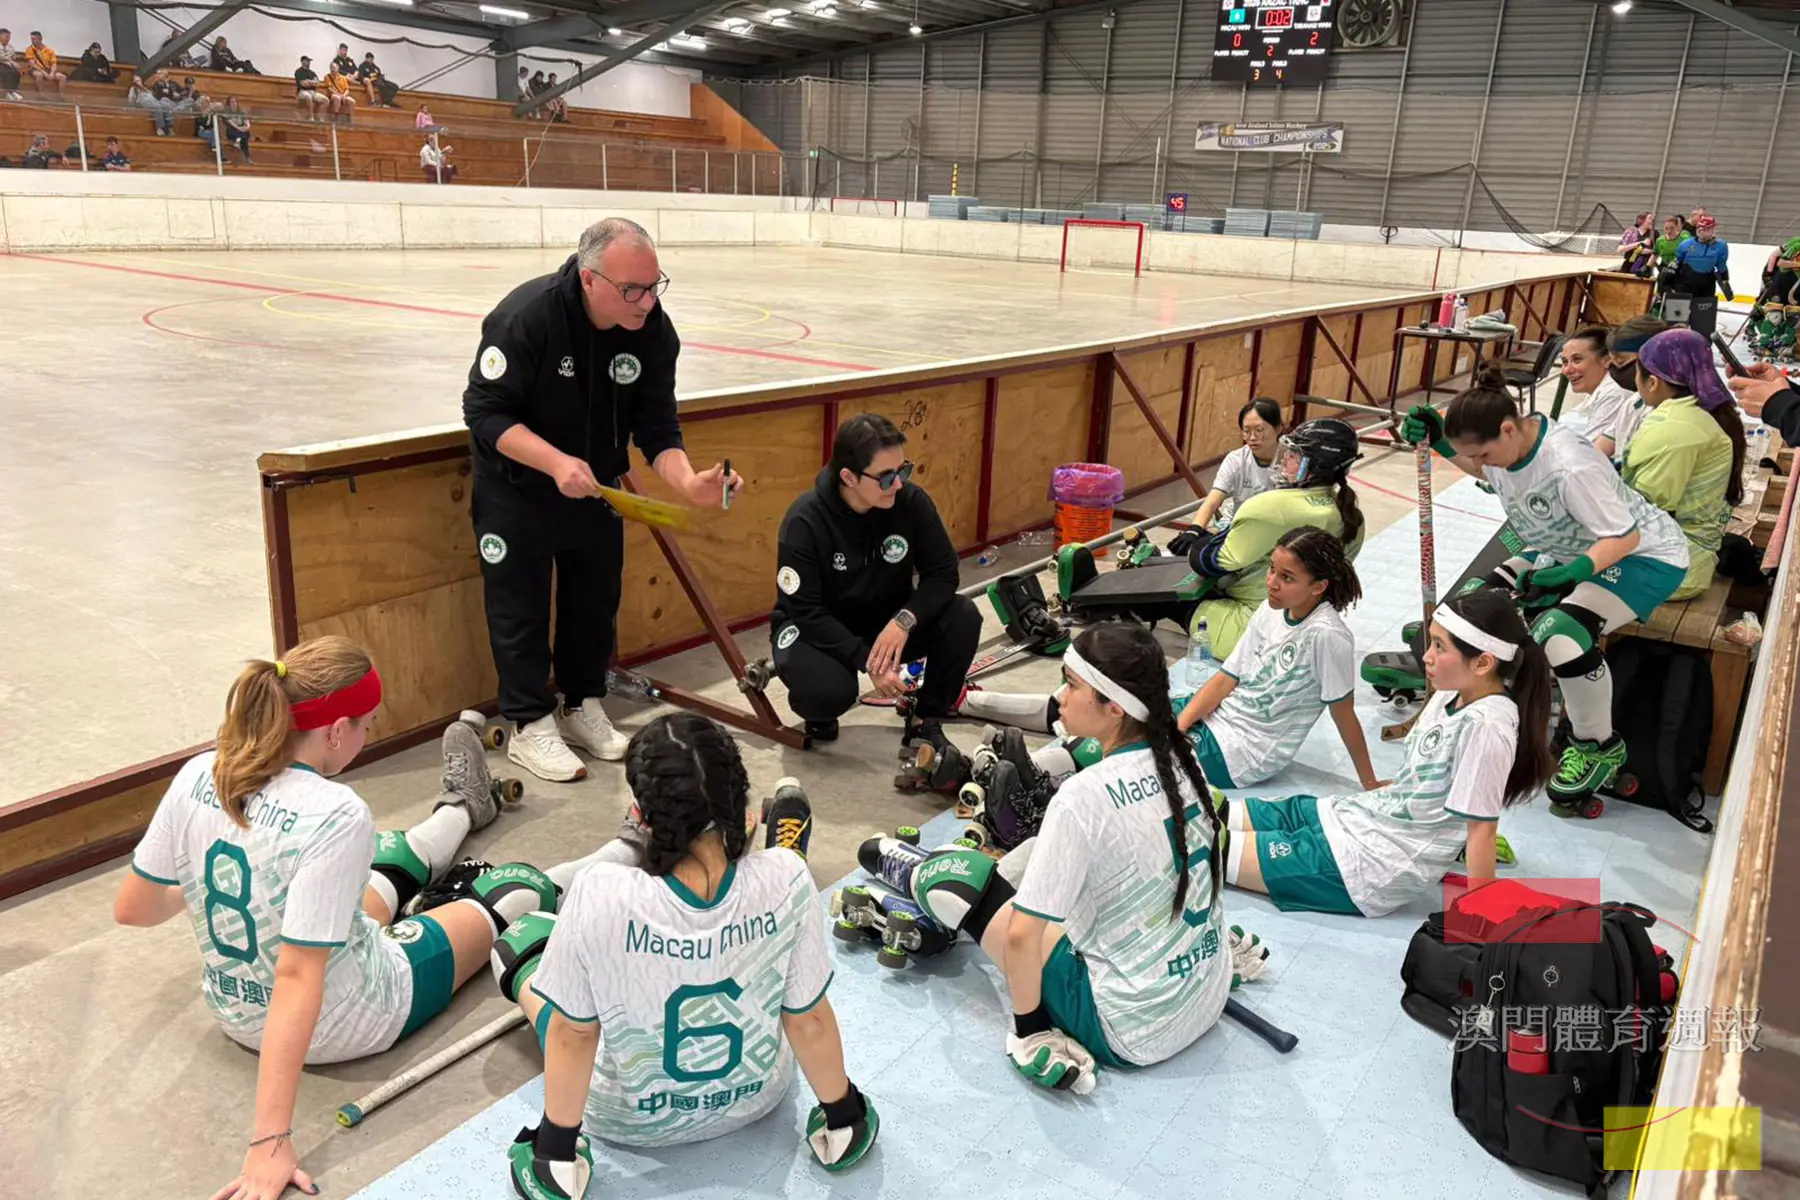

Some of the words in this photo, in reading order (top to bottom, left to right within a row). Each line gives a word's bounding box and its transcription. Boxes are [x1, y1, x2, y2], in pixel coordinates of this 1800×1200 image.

[1265, 10, 1291, 26] 0:02
[1233, 33, 1242, 47] 0
[1309, 31, 1319, 46] 2
[1266, 45, 1275, 57] 2
[1253, 69, 1260, 80] 3
[1275, 69, 1282, 80] 4
[1220, 134, 1250, 147] NATIONAL
[1253, 133, 1270, 145] CLUB
[1170, 196, 1184, 209] 45
[1105, 772, 1162, 810] Maca
[245, 791, 299, 834] China
[1163, 801, 1214, 928] 5
[204, 838, 259, 965] 8
[626, 919, 712, 961] Macau
[663, 976, 744, 1083] 6
[638, 1079, 764, 1115] 中國澳門
